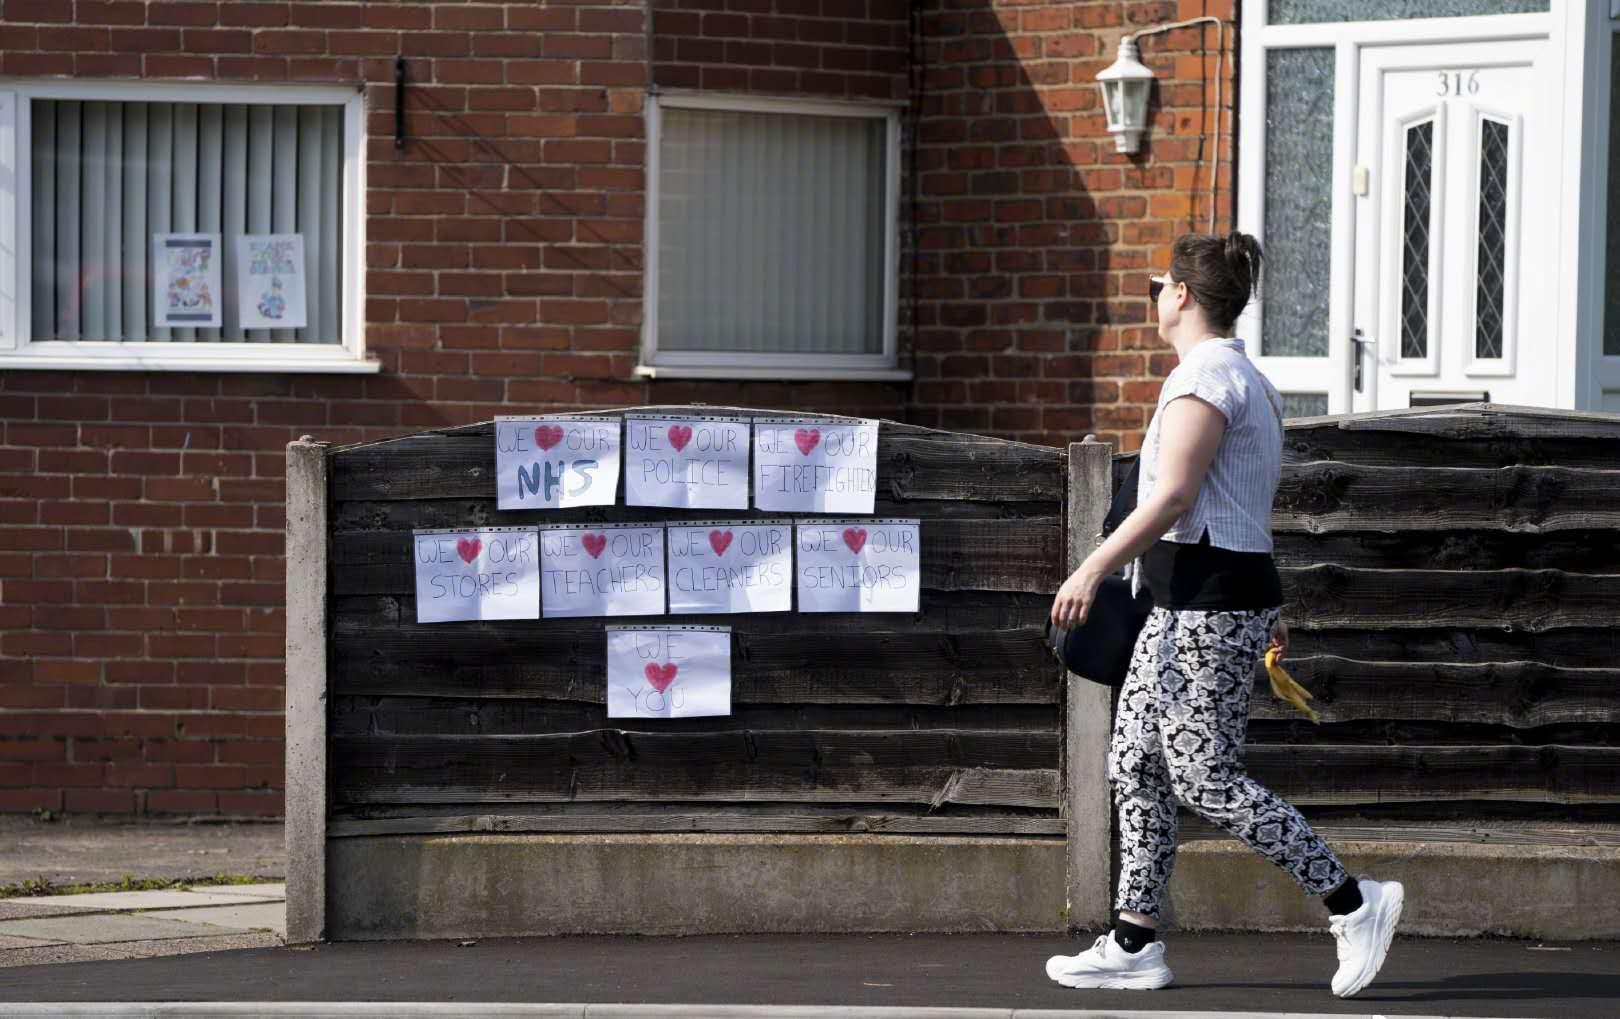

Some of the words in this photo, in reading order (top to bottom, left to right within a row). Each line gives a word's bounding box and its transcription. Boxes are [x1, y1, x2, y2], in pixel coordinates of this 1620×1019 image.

[1436, 69, 1480, 97] 316
[498, 427, 529, 453] WE
[566, 428, 610, 452] OUR
[630, 421, 664, 452] WE
[696, 427, 737, 453] OUR
[758, 428, 789, 455] WE
[824, 431, 871, 457] OUR
[517, 459, 599, 502] NHS
[643, 458, 731, 486] POLICE
[418, 538, 454, 564] WE
[488, 537, 531, 565] OUR
[543, 534, 577, 557] WE
[611, 532, 654, 558] OUR
[669, 529, 705, 557] WE
[740, 528, 782, 556] OUR
[800, 529, 839, 553] WE
[872, 530, 914, 554] OUR
[430, 571, 519, 599] STORES
[543, 562, 662, 596] TEACHERS
[675, 561, 785, 593] CLEANERS
[803, 563, 907, 590] SENIORS
[634, 632, 686, 660] WE
[626, 686, 687, 712] YOU
